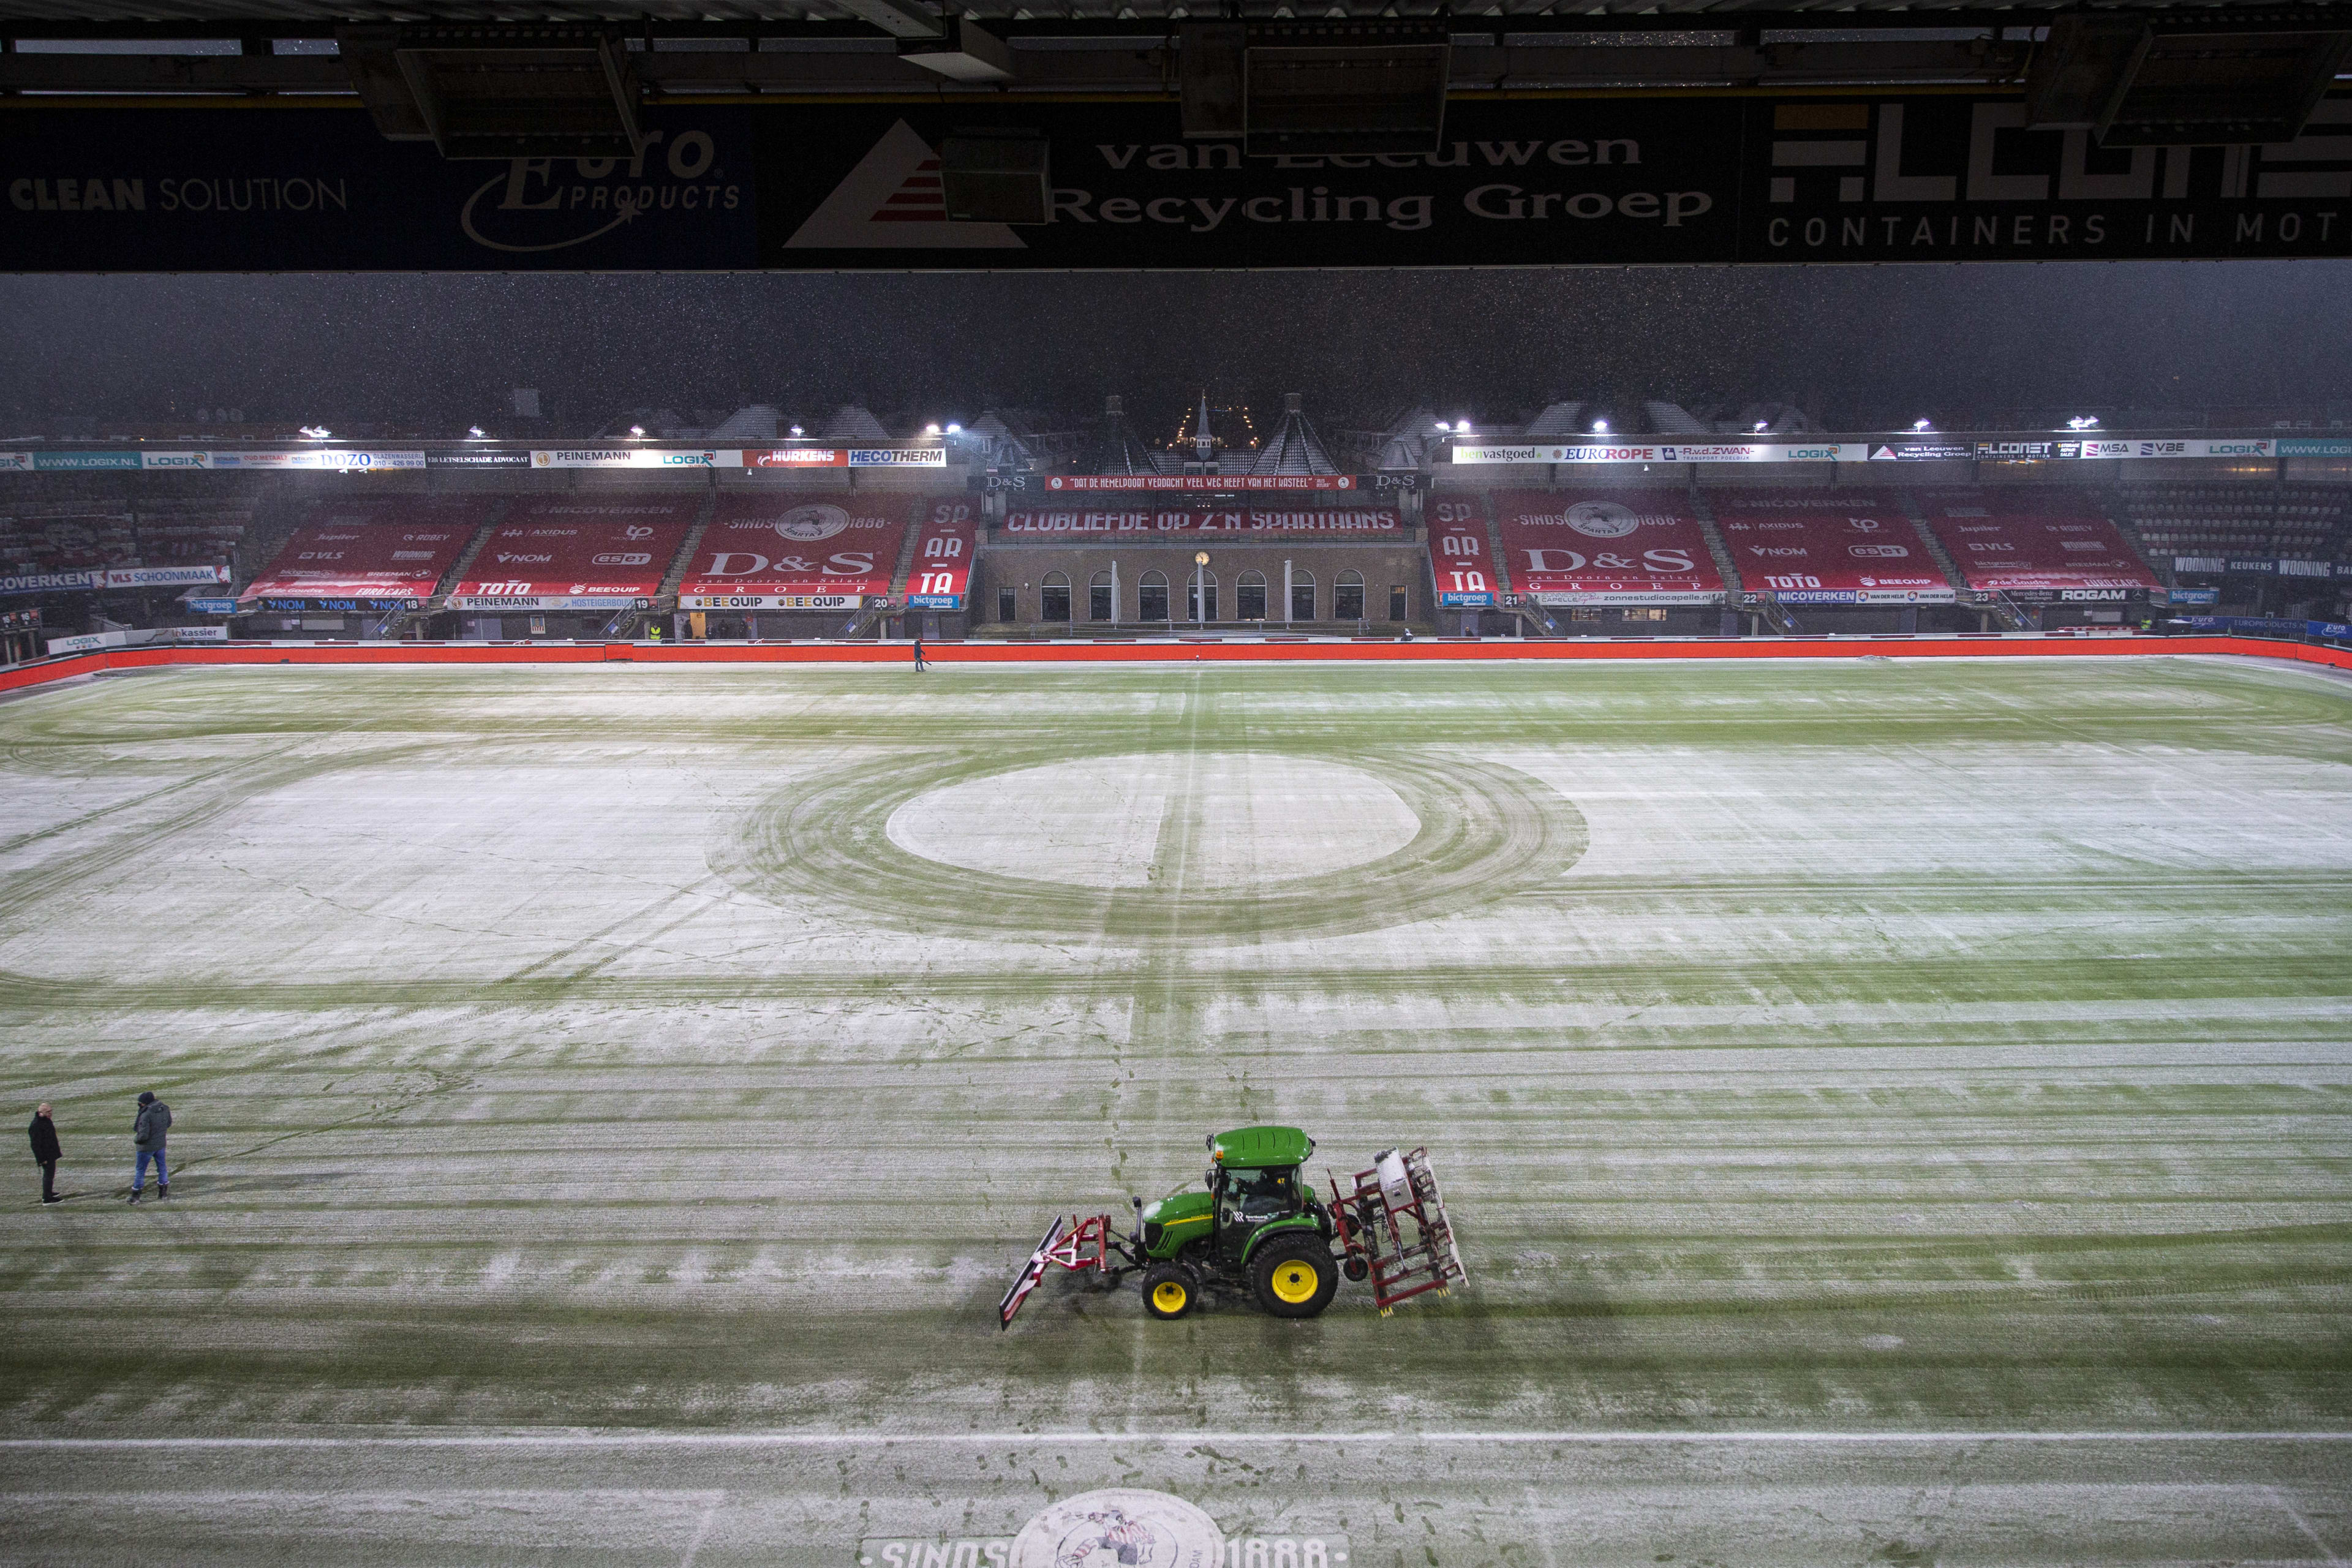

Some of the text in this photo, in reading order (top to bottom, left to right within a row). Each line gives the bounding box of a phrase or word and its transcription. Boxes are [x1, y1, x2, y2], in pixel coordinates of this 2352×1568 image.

[1096, 143, 1242, 170] van
[8, 178, 347, 211] CLEAN SOLUTION
[570, 185, 740, 209] PRODUCTS
[1050, 183, 1713, 232] Recycling Groep
[1768, 214, 2105, 246] CONTAINERS
[2145, 213, 2193, 243] IN
[1977, 442, 2051, 454] ALCONET
[2100, 443, 2129, 453] MSA
[2155, 443, 2185, 451] VBE
[2209, 445, 2265, 455] LOGIX
[557, 452, 630, 461] PEINEMANN
[772, 451, 835, 461] HURKENS
[851, 451, 942, 462] HECOTHERM
[1461, 447, 1536, 462] benvastgoed
[1564, 448, 1654, 459] EUROROPE
[1789, 450, 1836, 460] LOGIX
[148, 457, 204, 468] LOGIX
[321, 453, 371, 466] DOZO
[663, 456, 713, 466] LOGIX
[986, 477, 1025, 488] D&S
[1090, 478, 1098, 488] DE
[1101, 478, 1145, 488] HEMELPOORT
[1148, 478, 1183, 488] VERDACHT
[1186, 478, 1204, 488] VEEL
[1207, 478, 1221, 488] WEG
[1224, 478, 1245, 488] HEEFT
[1248, 478, 1261, 488] VAN
[1264, 478, 1277, 488] HET
[1376, 475, 1415, 486] D&S
[934, 505, 970, 523] SP
[1437, 503, 1471, 521] SP
[729, 518, 777, 529] SINDS
[1008, 510, 1395, 532] CLUBLIEFDE OP Z'N SPARTAANS
[1520, 514, 1564, 525] SINDS
[785, 527, 815, 537] SPARTA
[1578, 524, 1613, 534] SPARTA
[924, 538, 962, 557] AR
[1442, 536, 1480, 556] AR
[1768, 548, 1807, 556] NOM
[701, 552, 874, 575] D&S
[1520, 549, 1694, 572] D&S
[2175, 557, 2331, 576] WOONING KEUKENS WOONING
[111, 570, 214, 583] VLS SCHOONMAAK
[1450, 571, 1486, 591] TA
[1765, 575, 1821, 588] TOTO
[477, 581, 532, 595] TOTO
[921, 573, 953, 594] TA
[914, 595, 953, 605] bictgroep
[1448, 593, 1487, 603] bictgroep
[1506, 596, 1518, 605] 21
[1604, 593, 1711, 602] zonnestudiocapelle.nl
[1777, 592, 1855, 600] NICOVERKEN
[1975, 592, 1988, 601] 23
[2062, 590, 2125, 600] ROGAM
[2172, 590, 2214, 601] bictgroep
[190, 600, 232, 611] bictgroep
[277, 600, 305, 609] NOM
[329, 600, 356, 609] NOM
[405, 600, 417, 609] 18
[467, 597, 539, 606] PEINEMANN
[636, 600, 648, 608] 19
[704, 597, 763, 606] BEEQUIP
[786, 597, 845, 606] BEEQUIP
[2, 615, 10, 624] 16
[21, 612, 29, 621] 16
[67, 636, 101, 646] LOGIX
[1227, 1537, 1327, 1568] 1888
